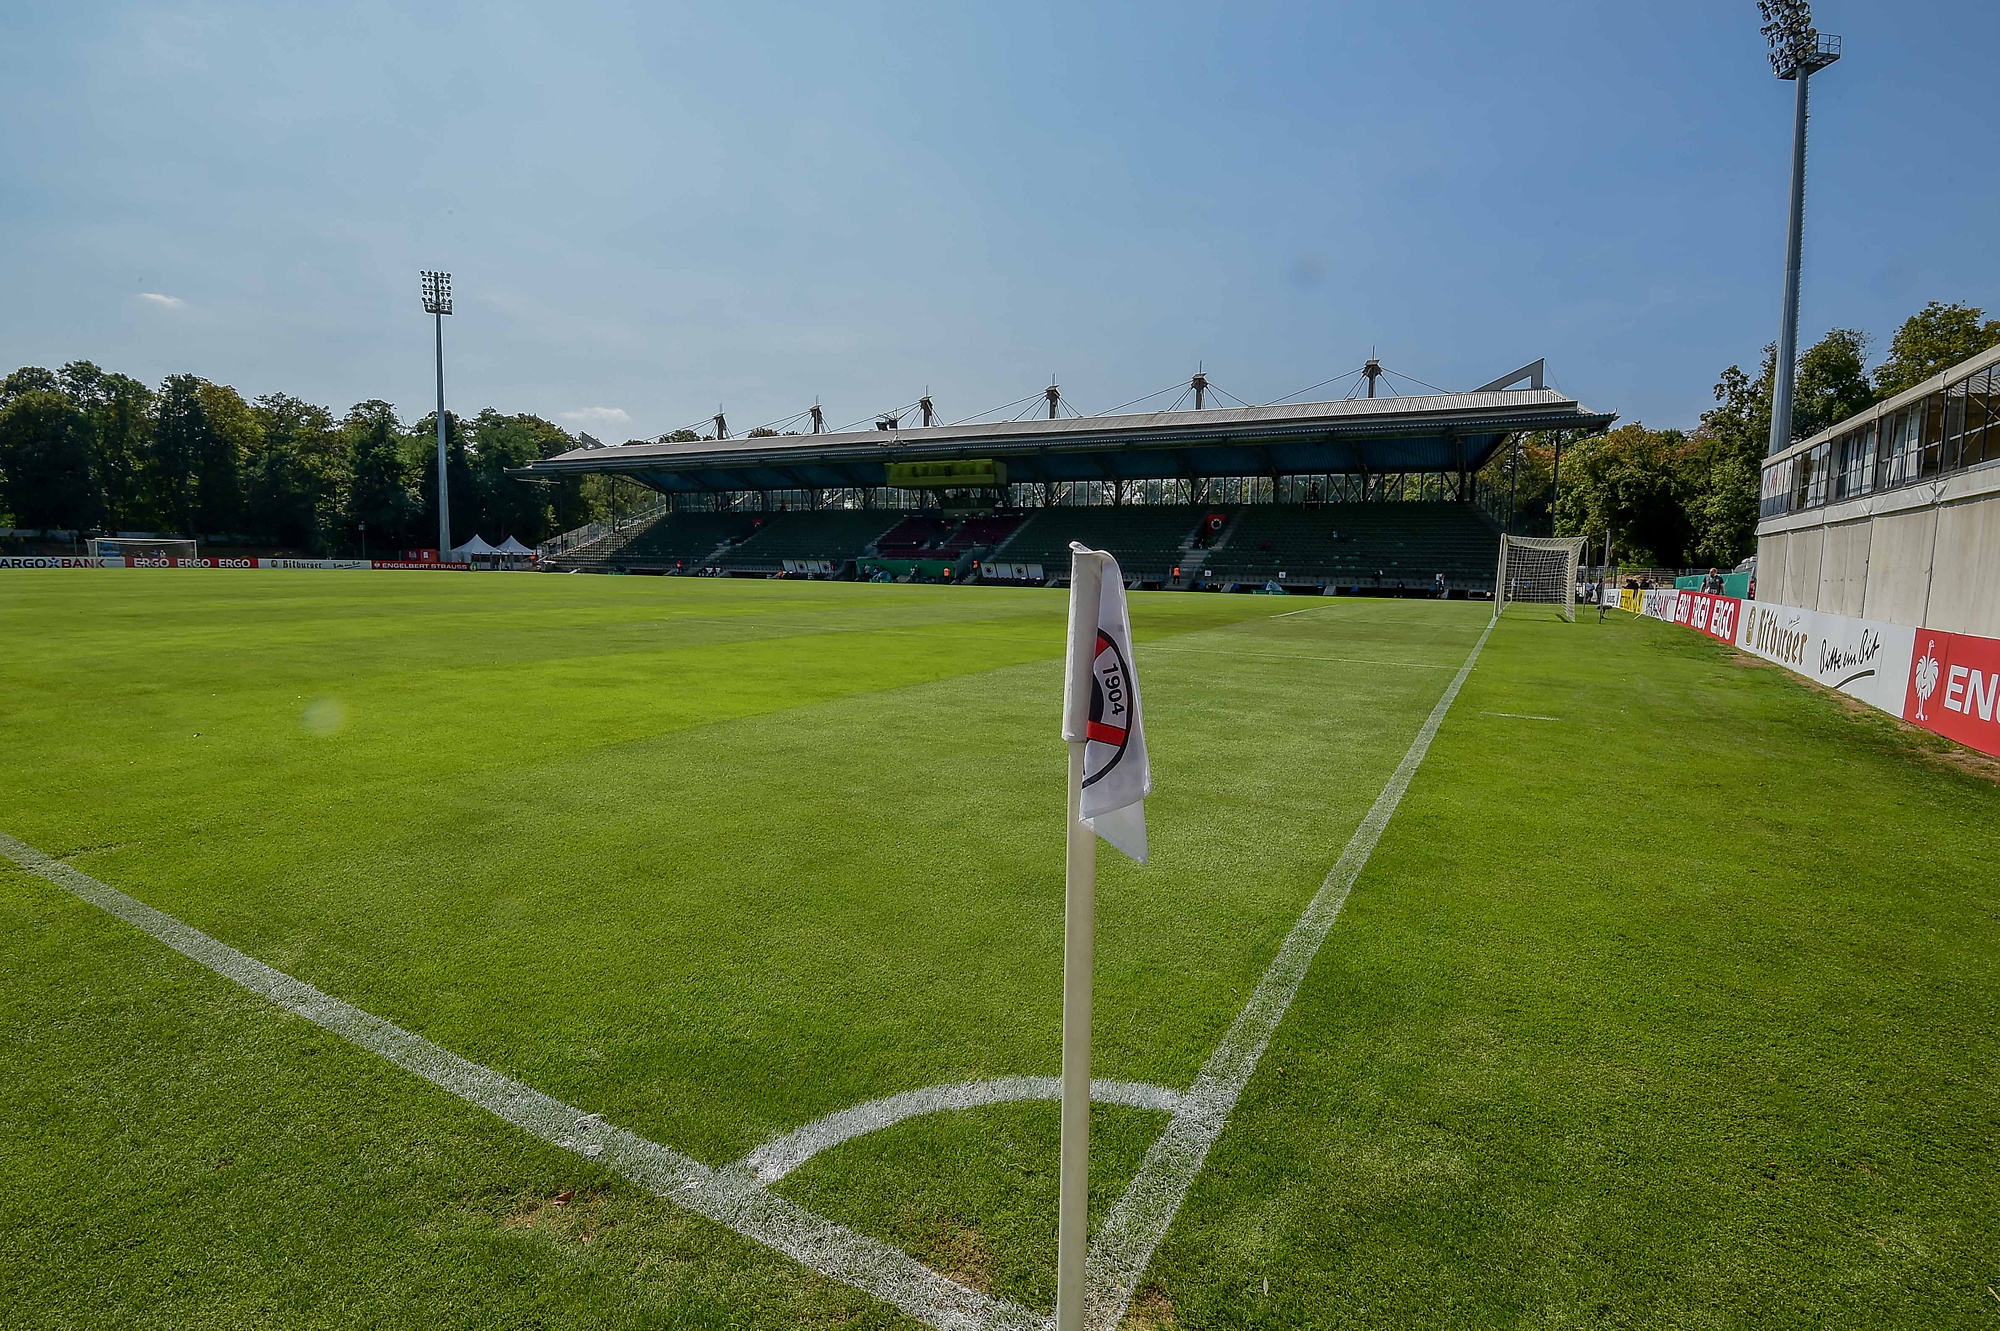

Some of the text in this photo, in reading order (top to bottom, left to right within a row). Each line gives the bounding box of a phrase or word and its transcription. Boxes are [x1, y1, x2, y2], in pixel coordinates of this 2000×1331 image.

[133, 557, 170, 568] ERGO
[177, 558, 211, 568] ERGO
[218, 558, 251, 568] ERGO
[282, 560, 323, 569] Bitburger
[1690, 595, 1711, 630] ERGO
[1710, 599, 1735, 640] ERGO
[1755, 607, 1808, 666] Bitburger
[1819, 627, 1881, 674] Bitte ein Bit
[1102, 663, 1125, 716] 1904
[1943, 664, 2000, 723] EN
